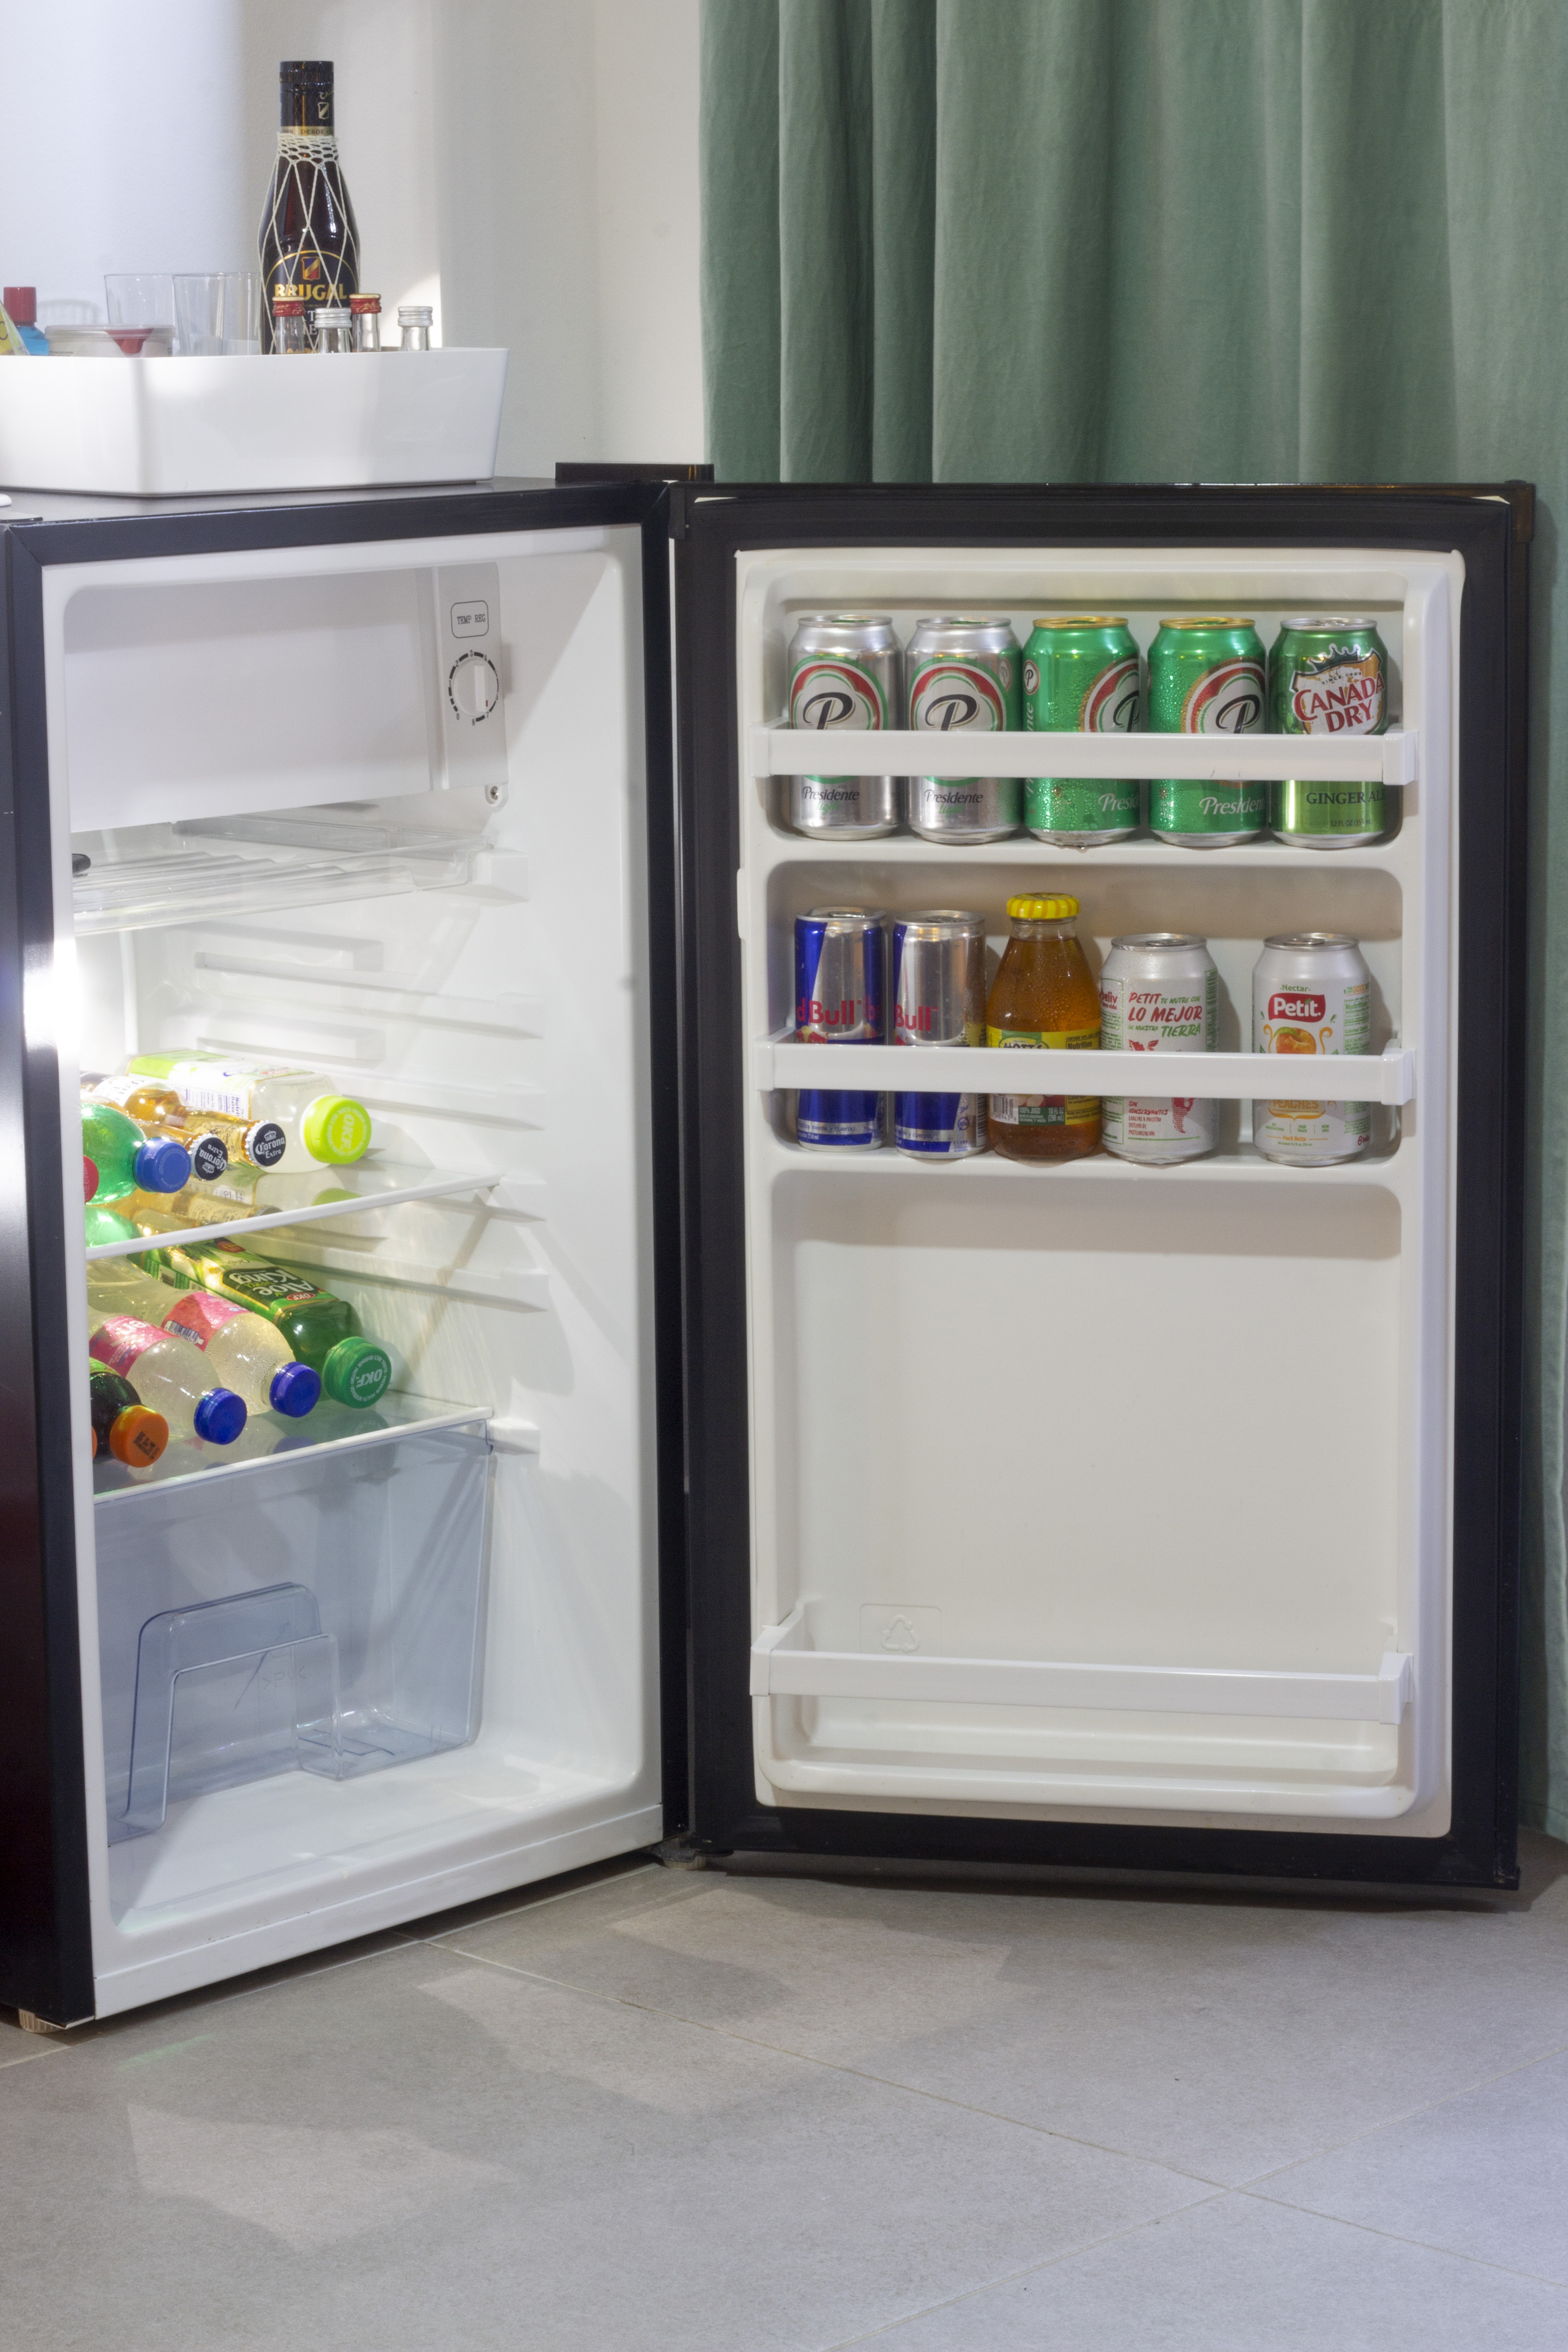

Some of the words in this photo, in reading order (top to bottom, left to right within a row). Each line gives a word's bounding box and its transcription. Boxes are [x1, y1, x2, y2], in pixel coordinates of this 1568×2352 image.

[274, 283, 347, 301] BRUGAL
[457, 615, 472, 625] TEMP
[475, 613, 486, 623] REG
[1321, 675, 1342, 685] SINCE
[1294, 671, 1385, 721] CANADA
[1325, 699, 1372, 733] DRY
[802, 786, 860, 801] Presidente
[923, 789, 984, 804] Presidente
[1306, 791, 1366, 804] GINGER
[1282, 984, 1309, 992] Nectar
[1128, 992, 1162, 1004] PETIT
[808, 1000, 855, 1026] Bull
[895, 1004, 931, 1031] Bull
[1128, 1006, 1147, 1022] LO
[1150, 1005, 1202, 1023] MEJOR
[1161, 1022, 1201, 1038] TIERRA
[207, 1144, 223, 1158] Extra
[255, 1137, 285, 1155] Corona
[265, 1149, 282, 1159] Extra
[199, 1149, 227, 1171] Corona
[229, 1269, 299, 1285] King
[252, 1279, 314, 1295] Aloe
[356, 1368, 383, 1388] OKF
